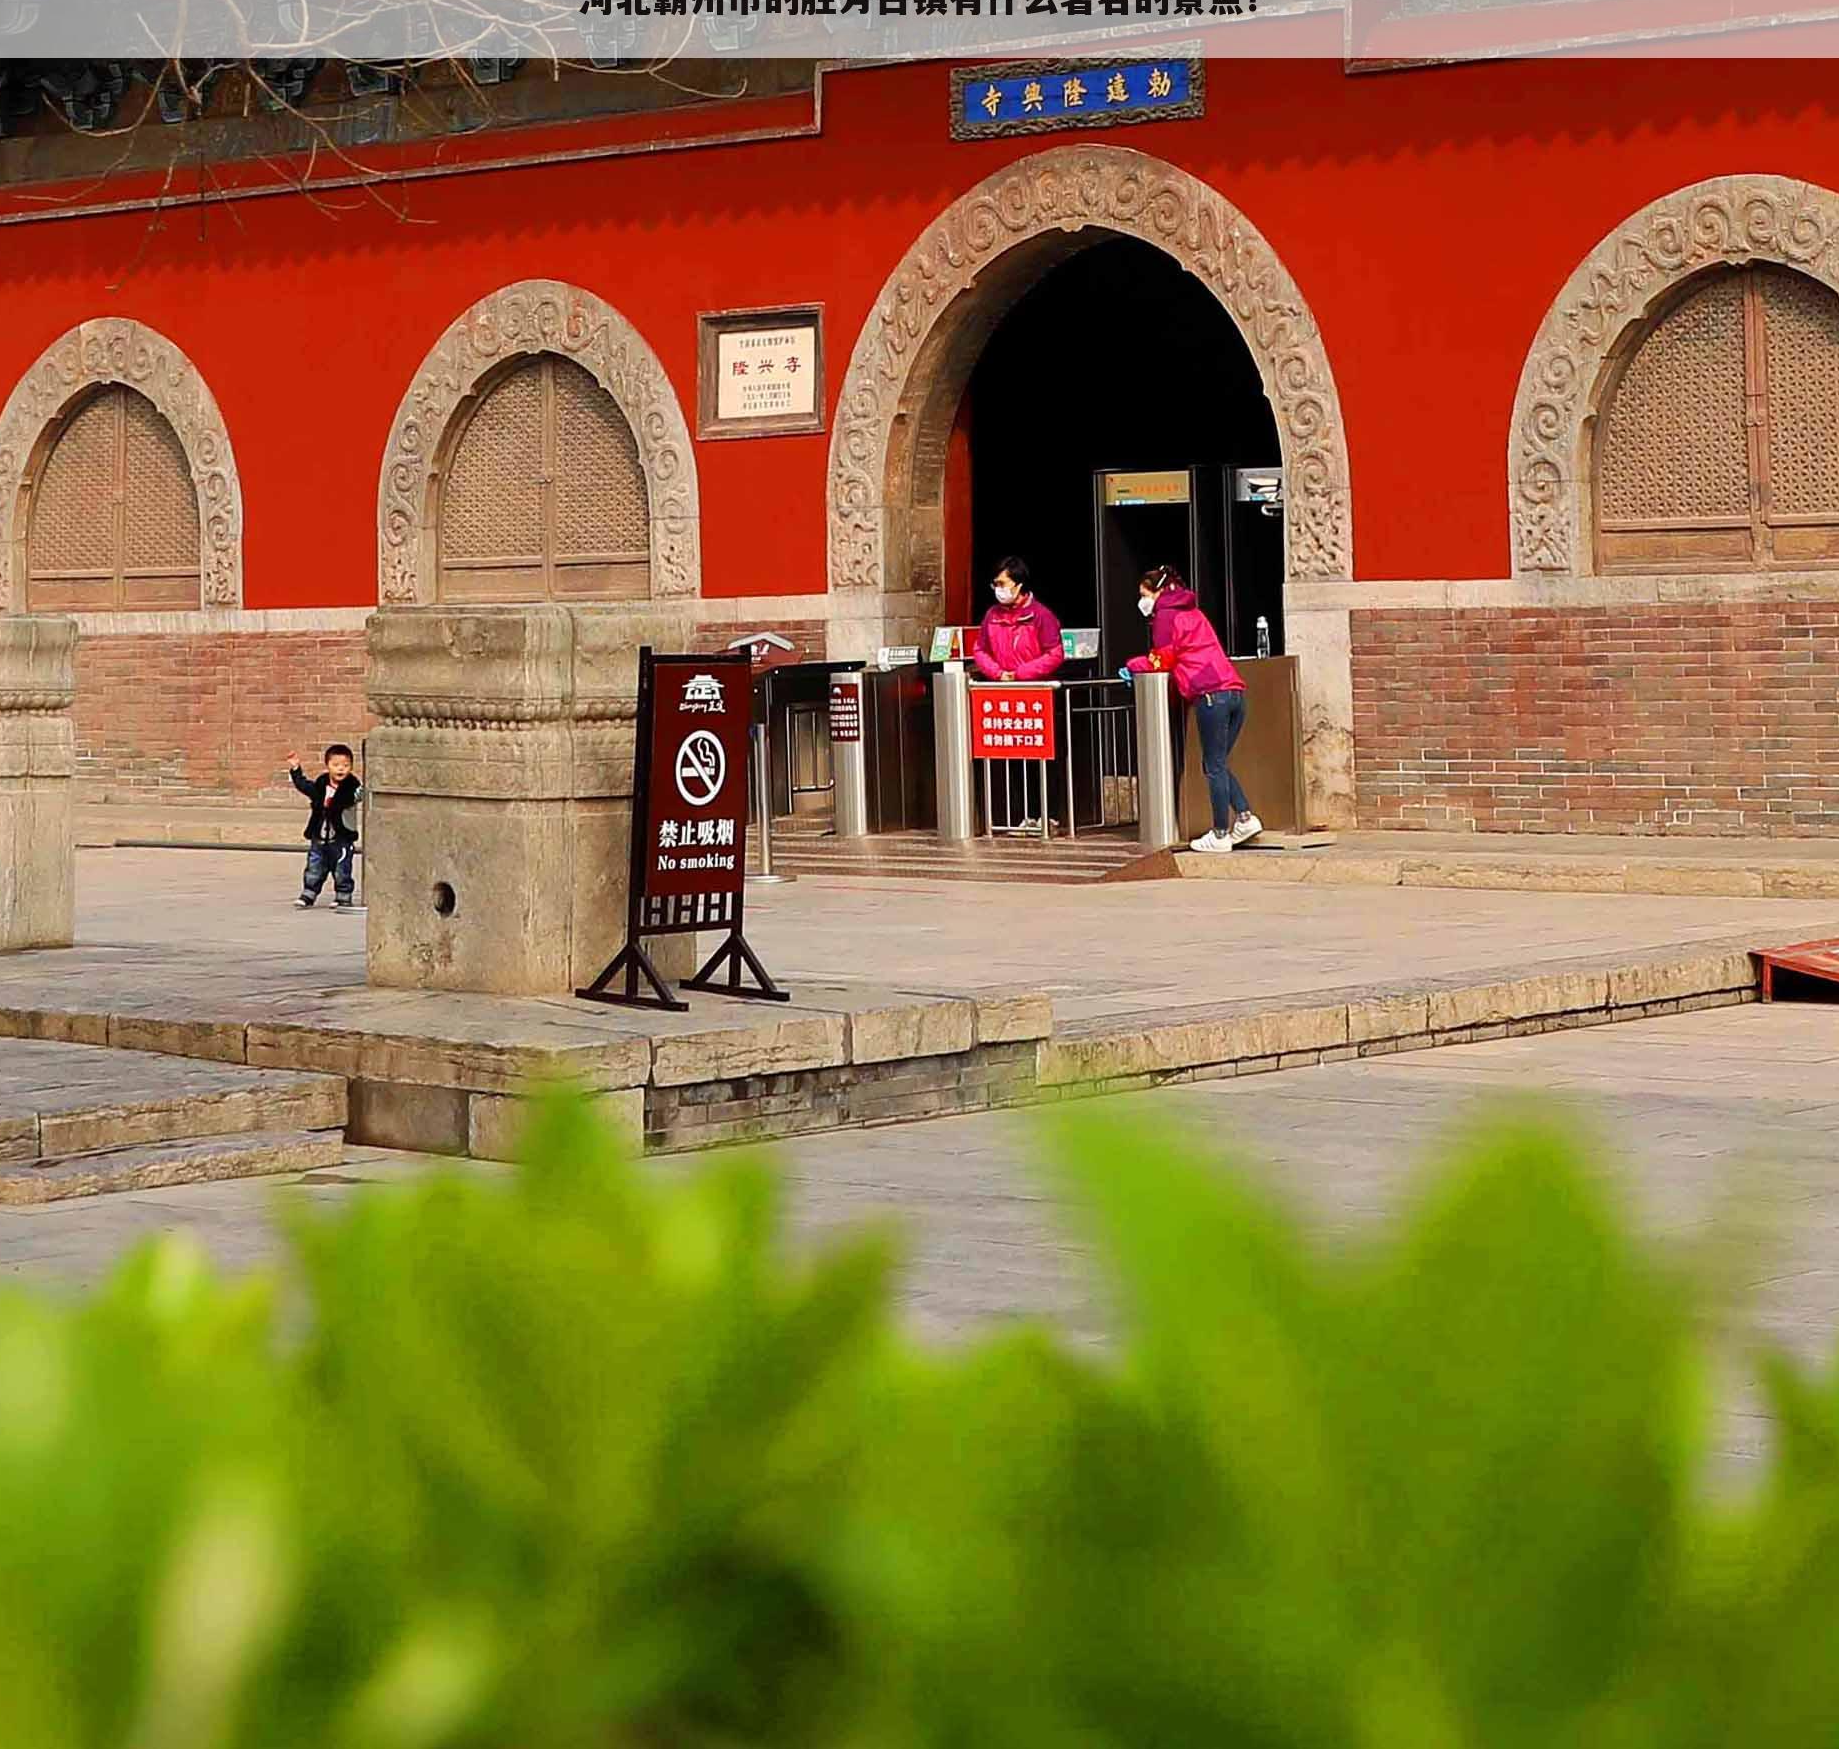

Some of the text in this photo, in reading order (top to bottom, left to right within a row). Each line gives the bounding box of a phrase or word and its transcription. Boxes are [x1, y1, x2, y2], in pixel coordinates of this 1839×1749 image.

[659, 819, 734, 848] 禁止吸烟
[657, 853, 735, 871] No smoking
